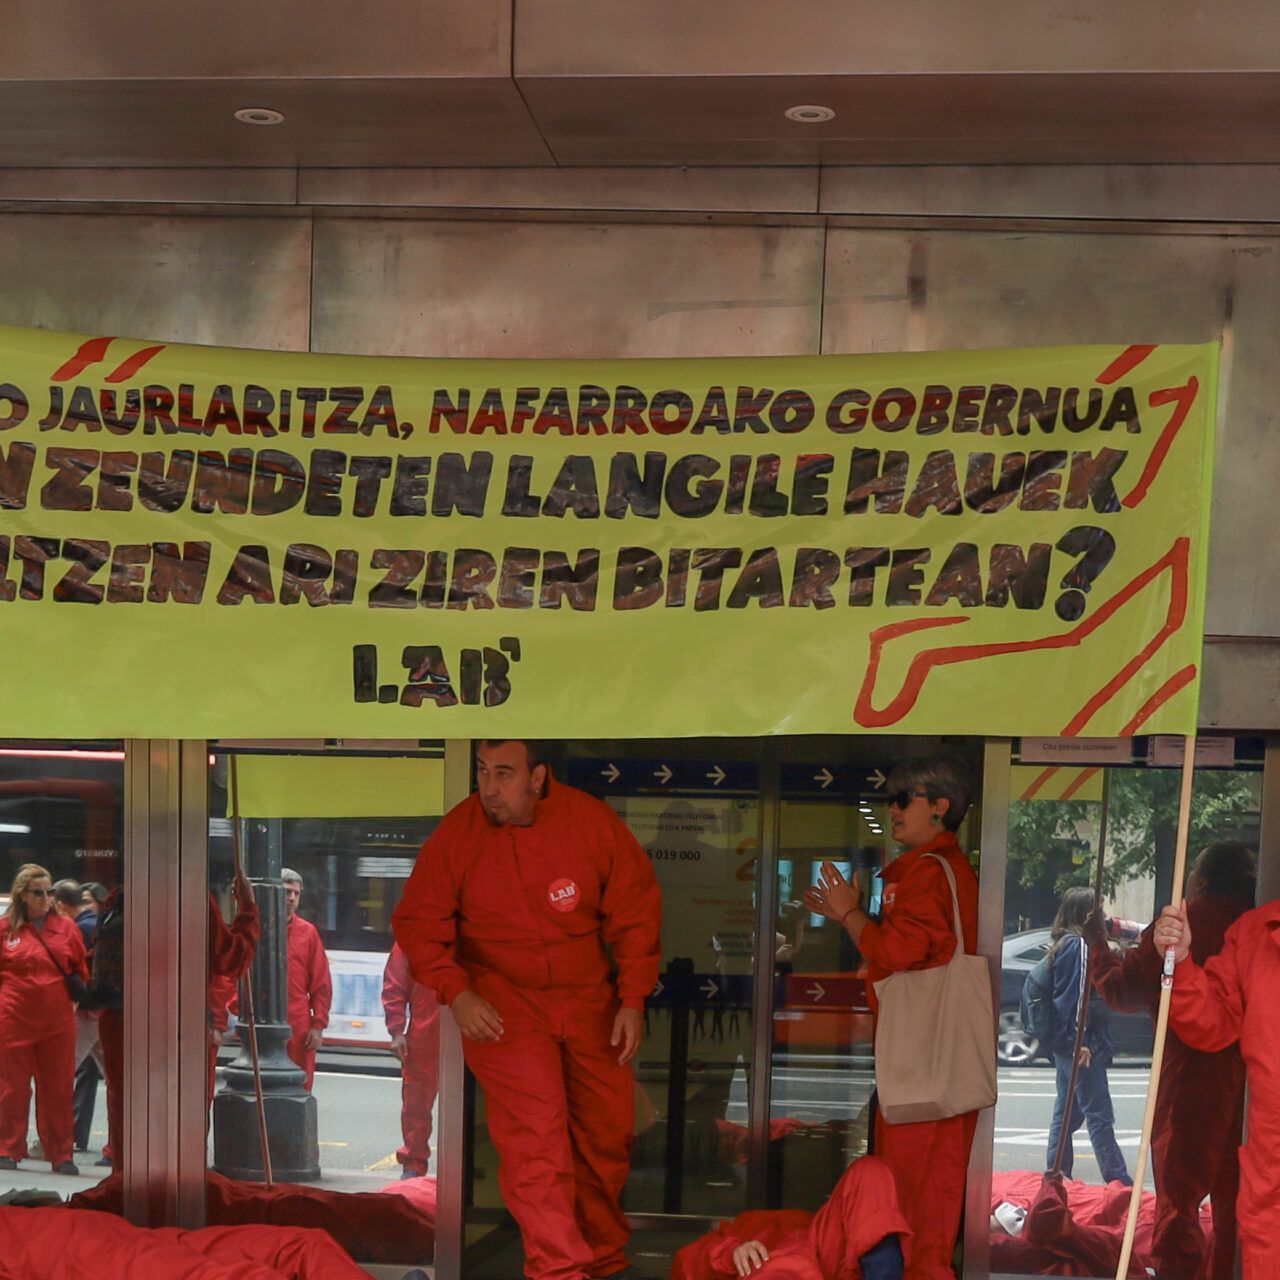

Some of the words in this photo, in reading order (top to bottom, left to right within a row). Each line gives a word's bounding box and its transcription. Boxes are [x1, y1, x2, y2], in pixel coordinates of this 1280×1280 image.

[39, 384, 415, 441] JAURLARITZA,
[429, 383, 815, 437] NAFARROAKO
[825, 384, 1142, 437] GOBERNUA
[40, 446, 493, 518] ZEUNDETEN
[501, 450, 833, 519] LANGILE
[841, 446, 1131, 516] HAUEK
[217, 543, 358, 608] ARI
[367, 546, 601, 612] ZIREN
[612, 525, 1117, 622] BITARTEAN?
[656, 850, 677, 861] 019
[679, 850, 702, 861] 000
